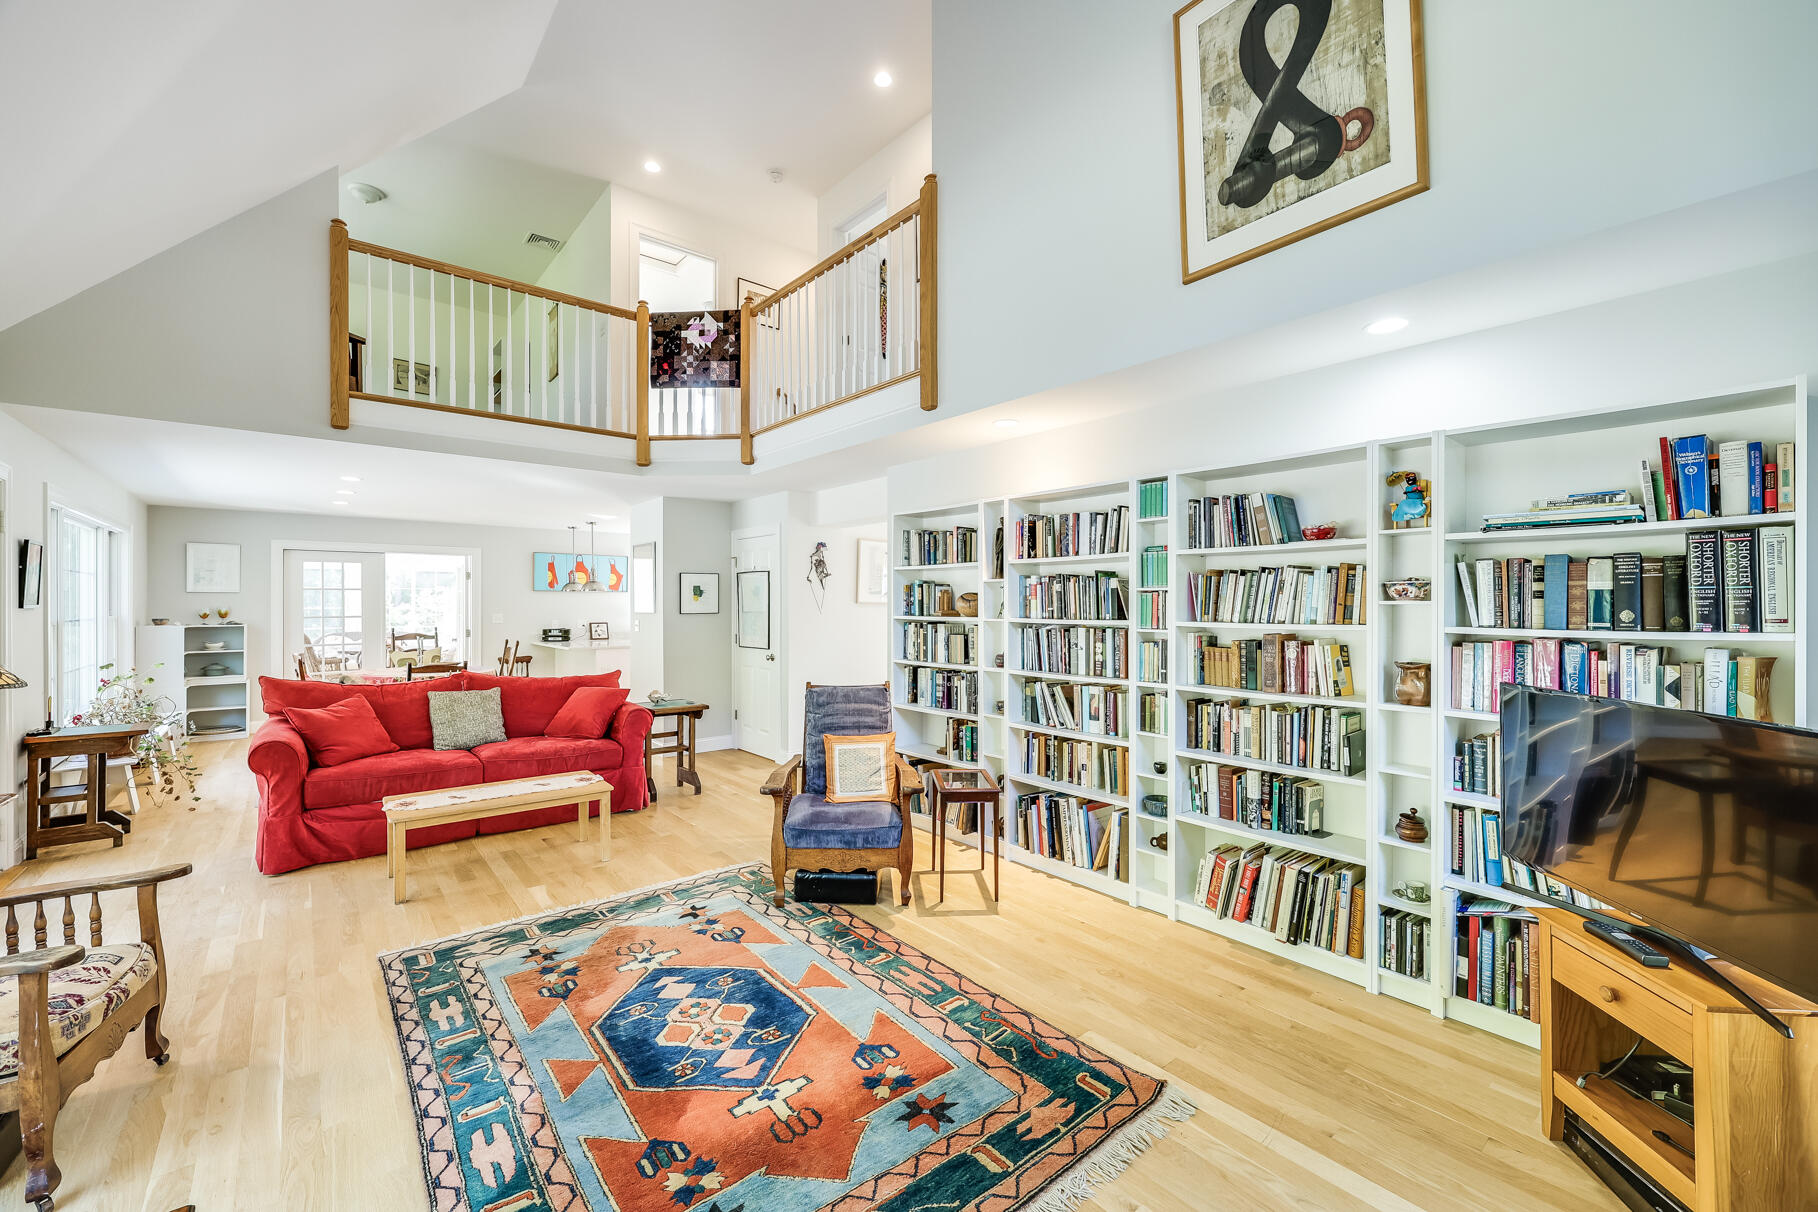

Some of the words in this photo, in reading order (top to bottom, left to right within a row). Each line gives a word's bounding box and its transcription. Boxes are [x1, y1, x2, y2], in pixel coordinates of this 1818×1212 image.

[1690, 543, 1702, 585] OXFORD
[1702, 542, 1714, 585] SHORTER
[1725, 542, 1738, 585] OXFORD
[1739, 541, 1751, 584] SHORTER
[1766, 540, 1775, 566] AMERICAN
[1767, 567, 1776, 591] REGIONAL
[1768, 593, 1777, 614] ENGLISH
[1516, 652, 1525, 685] LANGUAG
[1569, 654, 1579, 694] DICTIONA
[1352, 894, 1362, 939] Rembrandt's
[1482, 932, 1492, 963] PICASSO
[1495, 954, 1505, 994] PAINTERS
